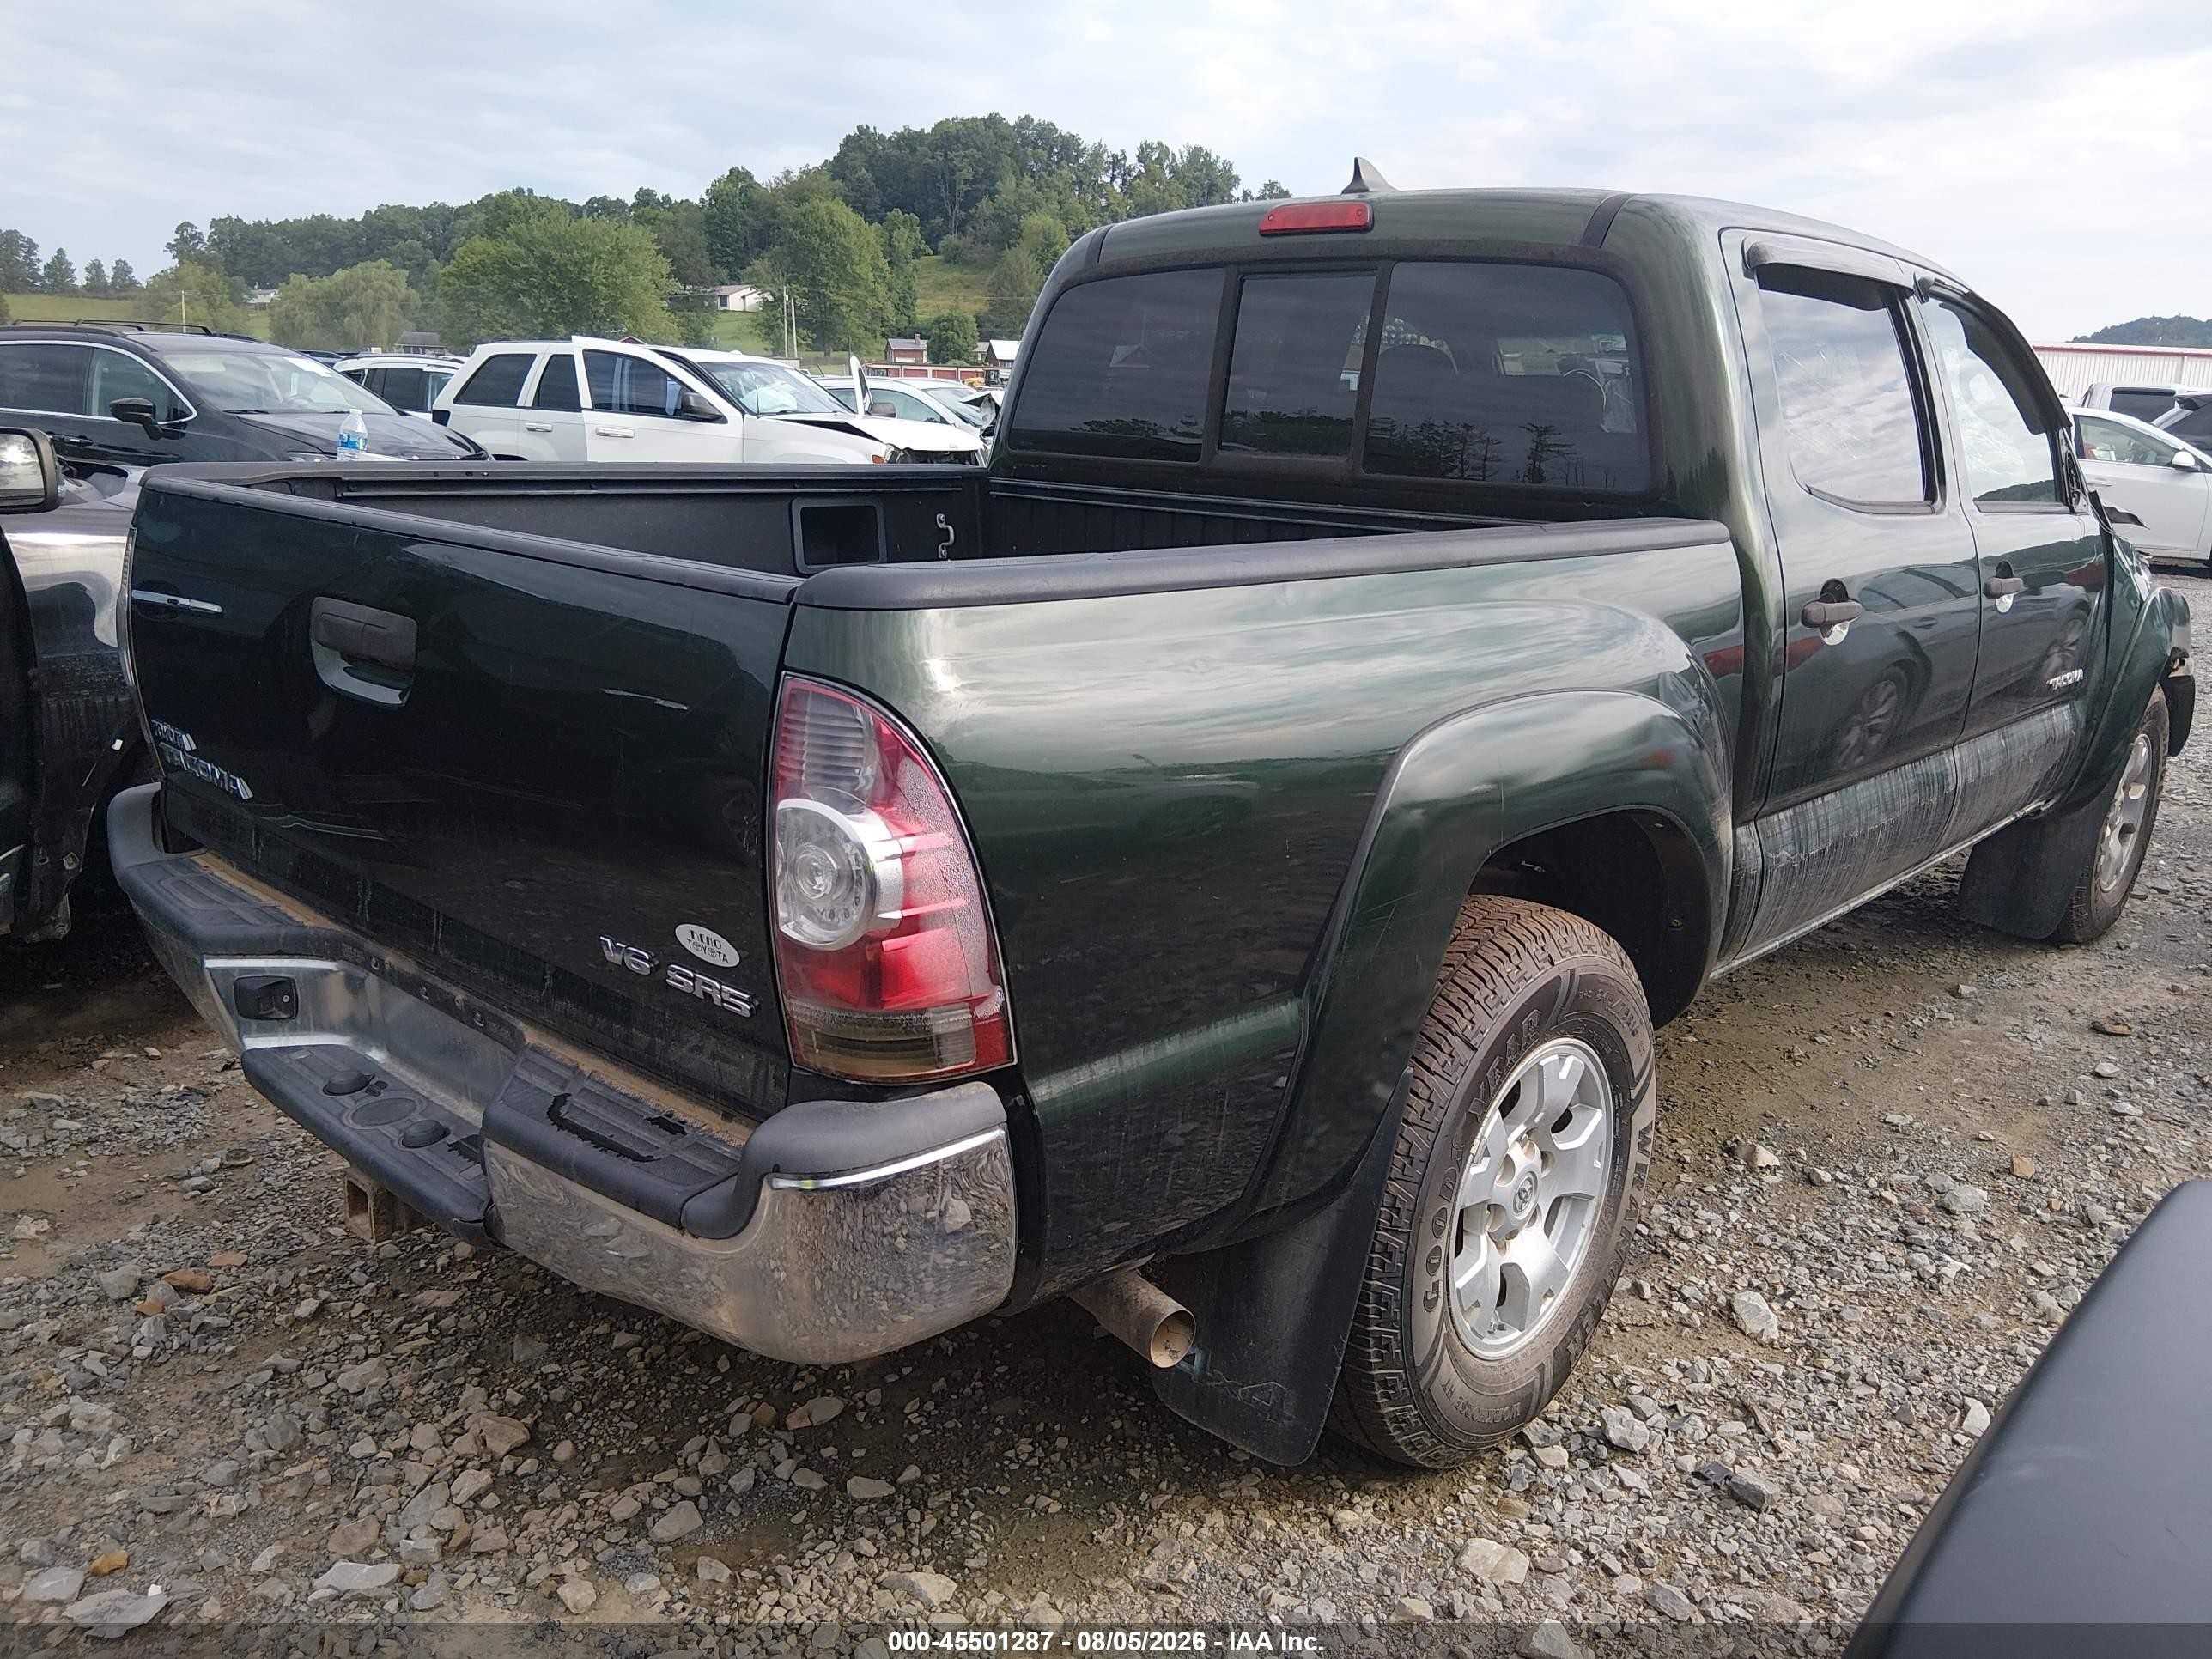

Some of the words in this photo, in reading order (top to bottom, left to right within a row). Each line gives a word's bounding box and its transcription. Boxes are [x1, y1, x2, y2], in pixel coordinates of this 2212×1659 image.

[159, 741, 253, 799] TACOMA
[599, 934, 654, 976] V6
[665, 963, 756, 1018] SR5
[687, 938, 729, 964] TOYOTA
[1422, 1008, 1543, 1313] GOODYEAR
[1567, 1120, 1656, 1369] WRANGLER
